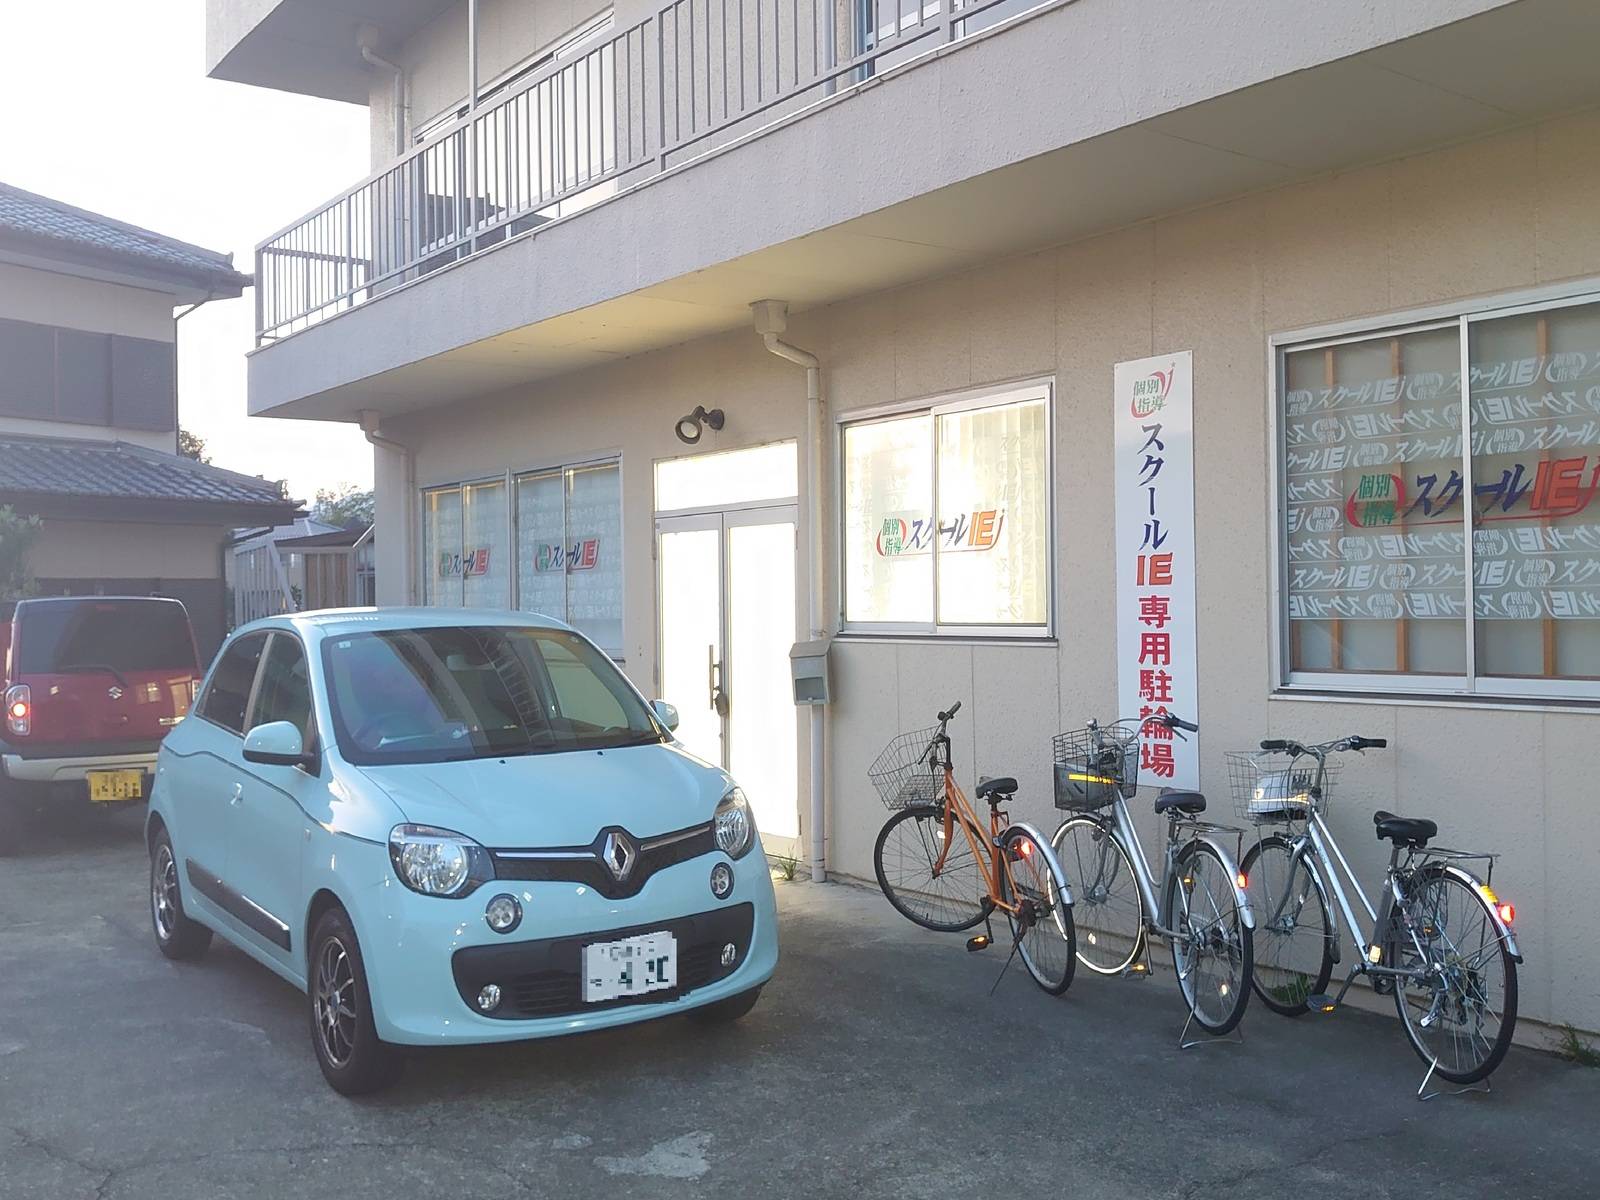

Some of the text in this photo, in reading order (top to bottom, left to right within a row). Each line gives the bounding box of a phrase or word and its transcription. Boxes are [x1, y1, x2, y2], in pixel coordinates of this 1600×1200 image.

[1358, 473, 1392, 499] 個別
[1401, 456, 1588, 518] スクールIE
